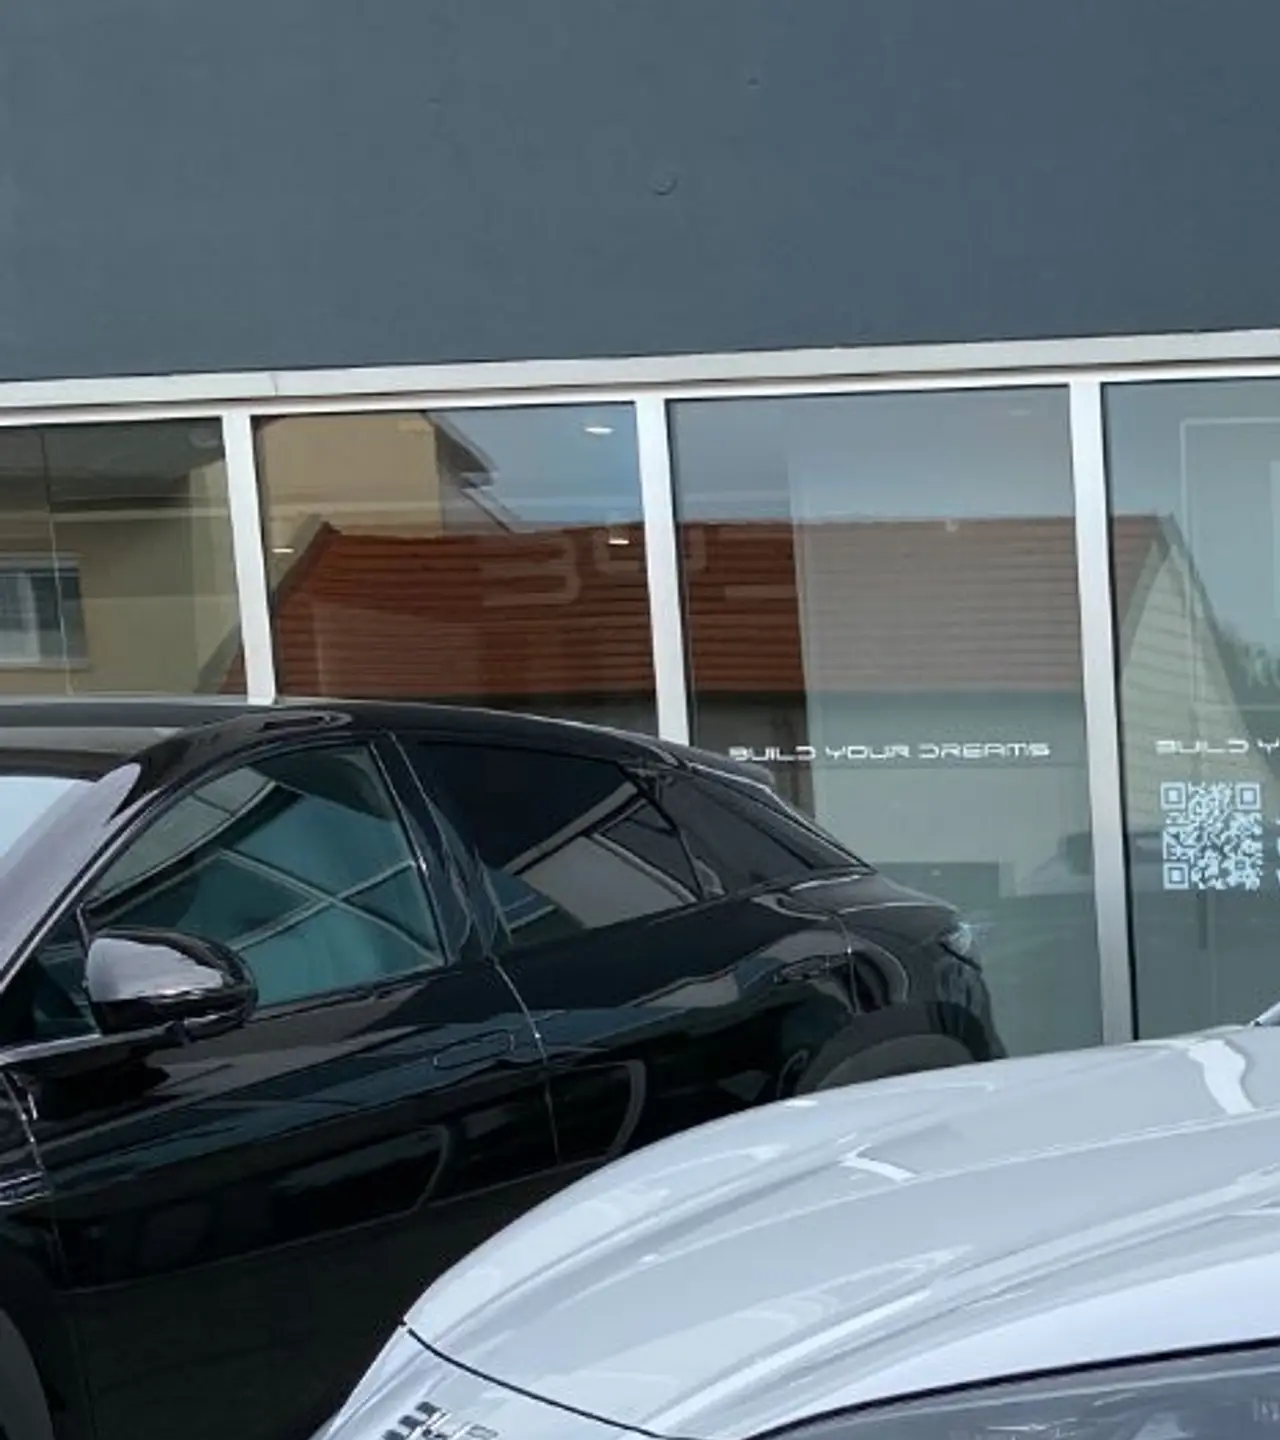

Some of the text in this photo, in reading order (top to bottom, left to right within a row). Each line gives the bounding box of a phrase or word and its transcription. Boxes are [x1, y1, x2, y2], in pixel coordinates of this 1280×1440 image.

[729, 741, 1052, 761] BUILD YOUR DREAMS
[1154, 739, 1249, 754] BUILD
